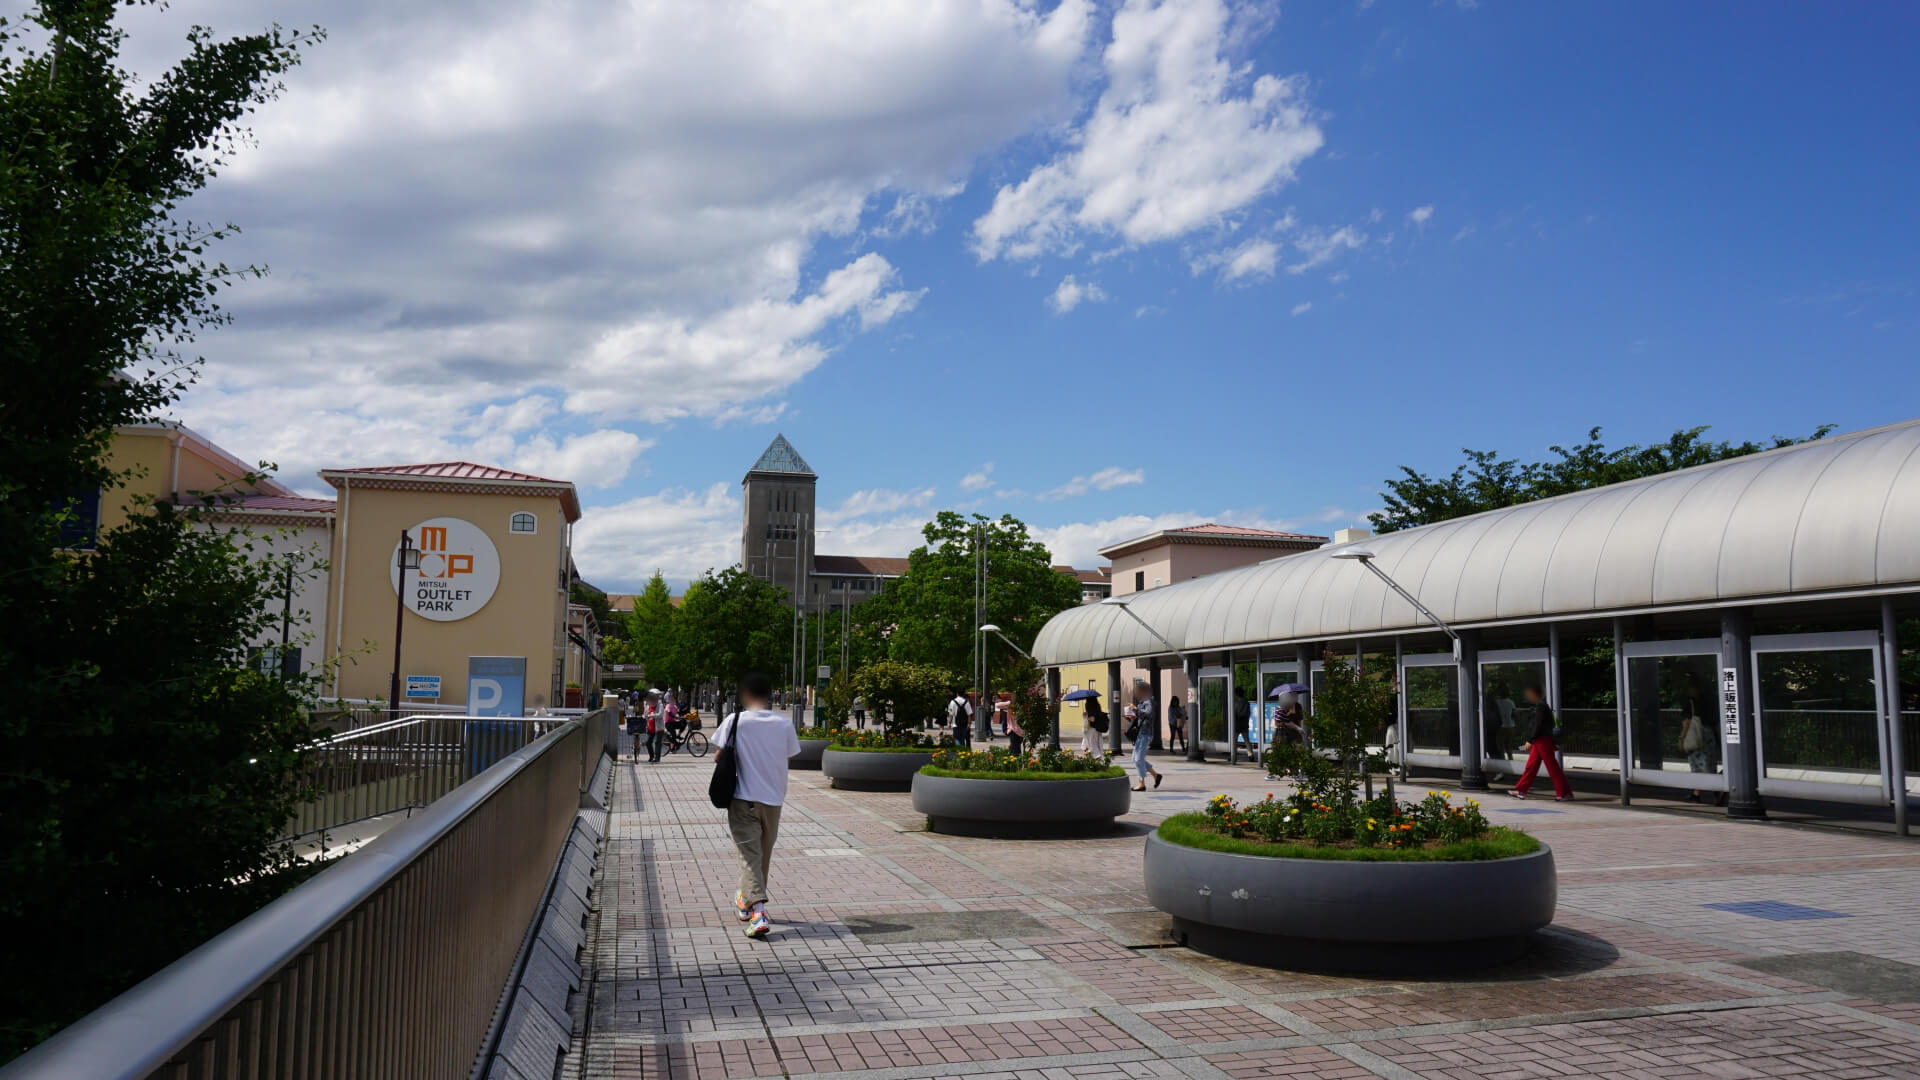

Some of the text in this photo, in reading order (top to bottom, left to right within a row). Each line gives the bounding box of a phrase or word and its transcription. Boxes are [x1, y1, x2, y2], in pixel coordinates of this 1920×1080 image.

[417, 589, 472, 600] OUTLET
[417, 601, 453, 611] PARK
[469, 679, 502, 718] P
